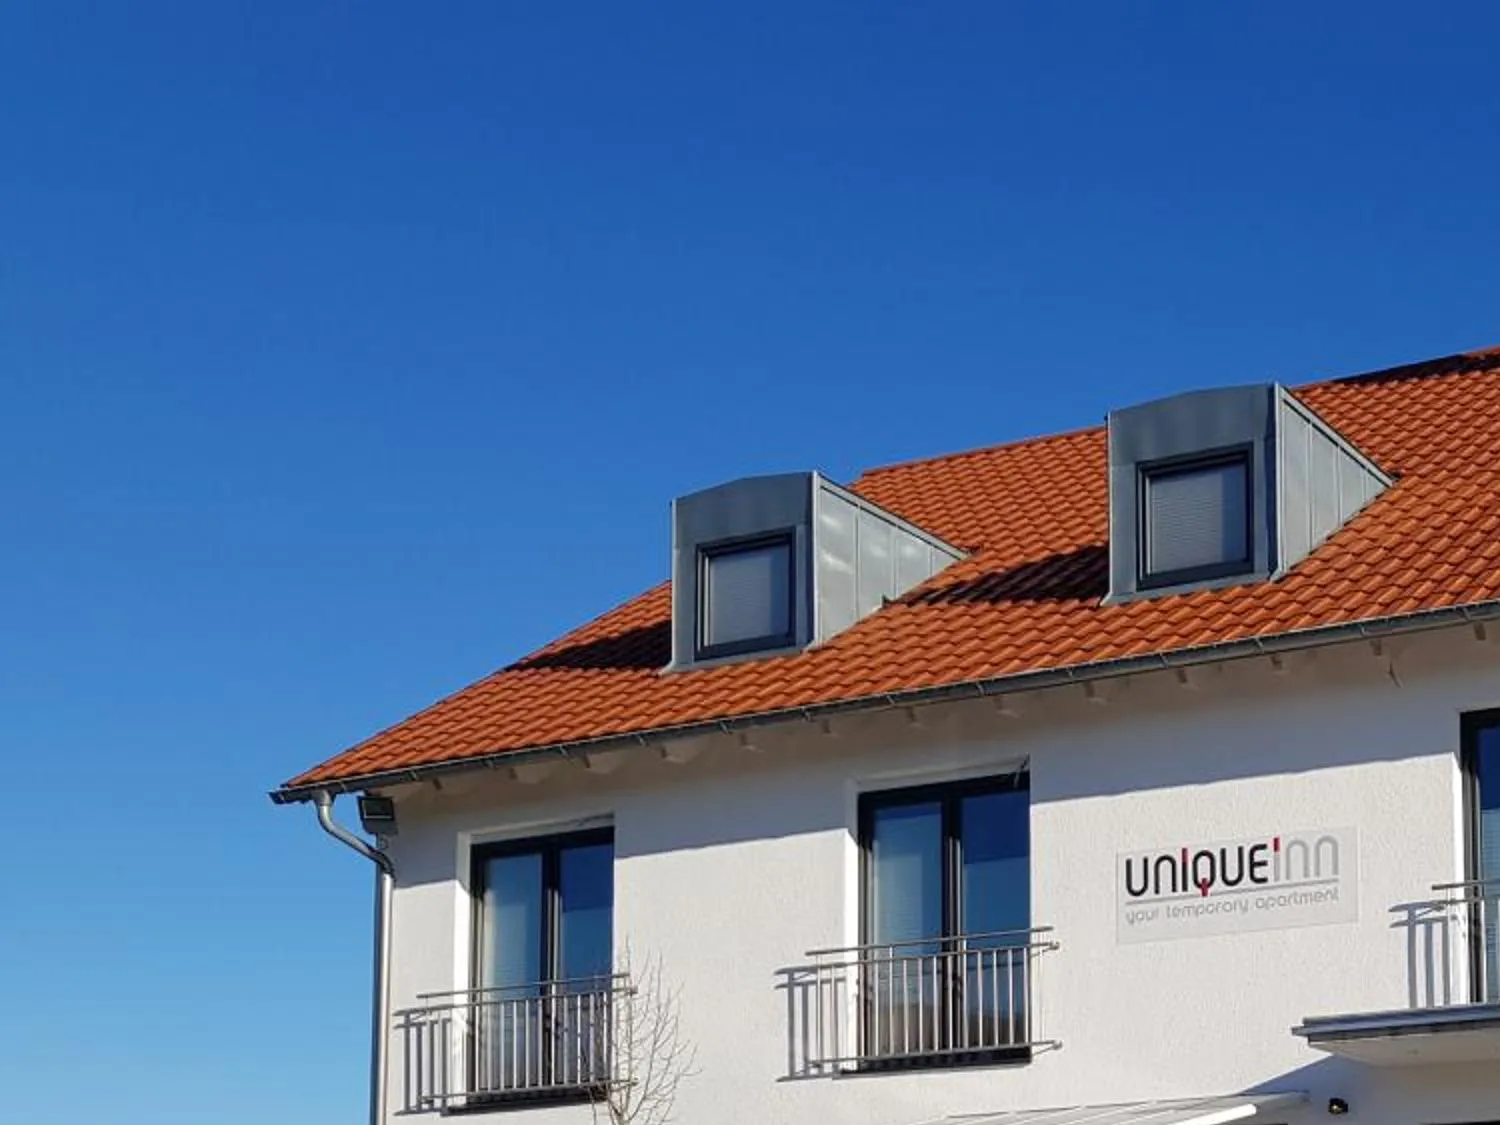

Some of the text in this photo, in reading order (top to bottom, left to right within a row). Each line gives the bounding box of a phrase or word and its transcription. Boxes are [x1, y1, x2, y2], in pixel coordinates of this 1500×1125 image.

[1125, 886, 1339, 925] your temporary apartment
